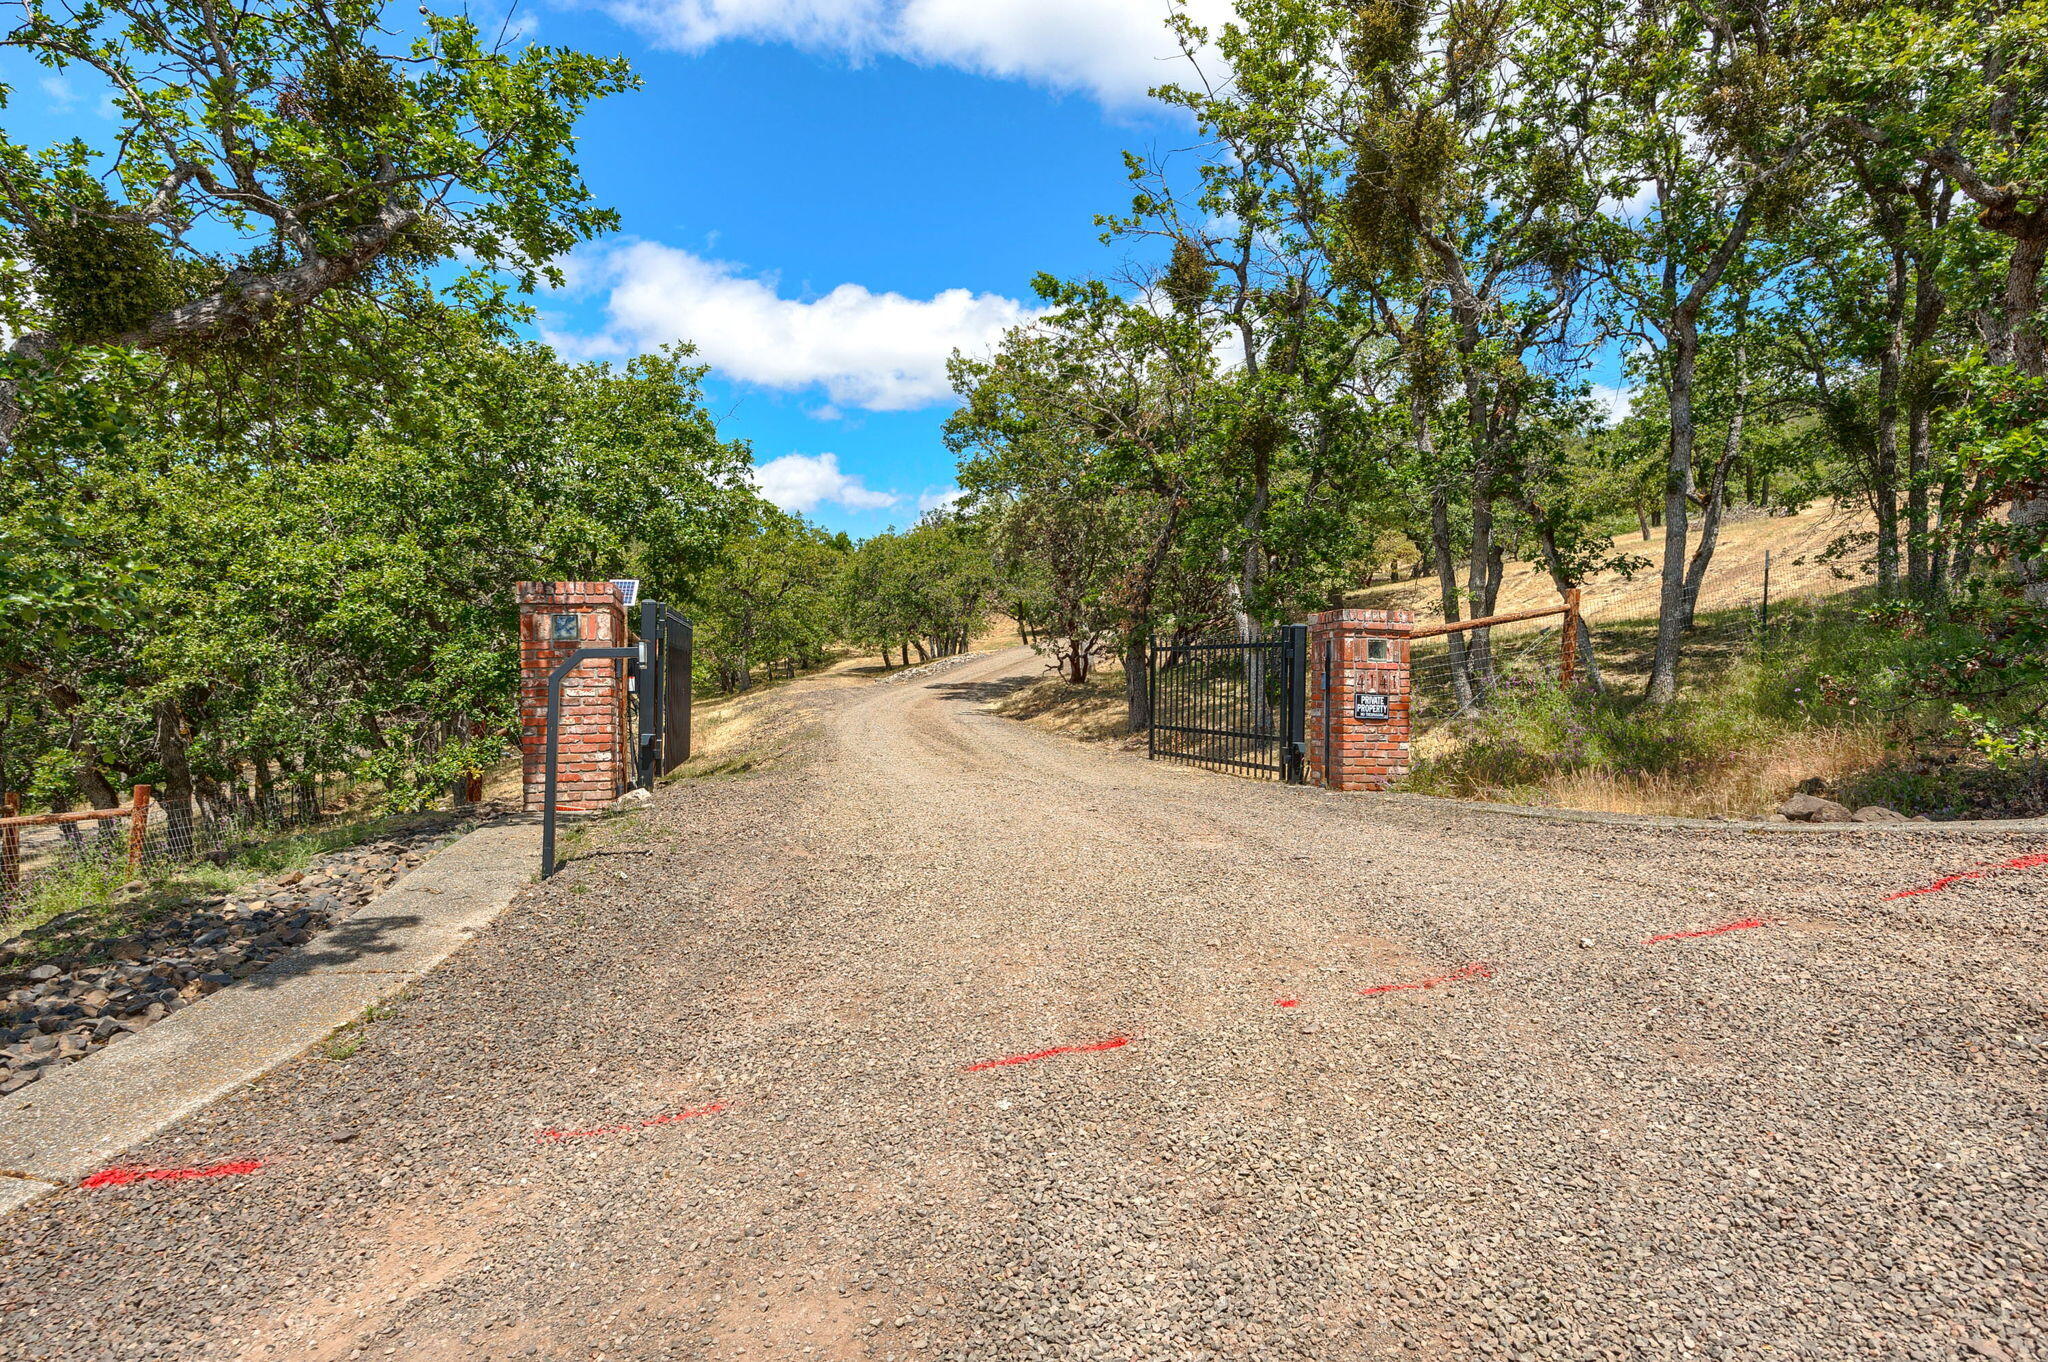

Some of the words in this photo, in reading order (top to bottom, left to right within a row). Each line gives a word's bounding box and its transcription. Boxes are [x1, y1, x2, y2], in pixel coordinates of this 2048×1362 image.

[1356, 674, 1396, 689] 4141
[1361, 695, 1384, 705] PRIVATE
[1357, 704, 1387, 713] PROPERTY
